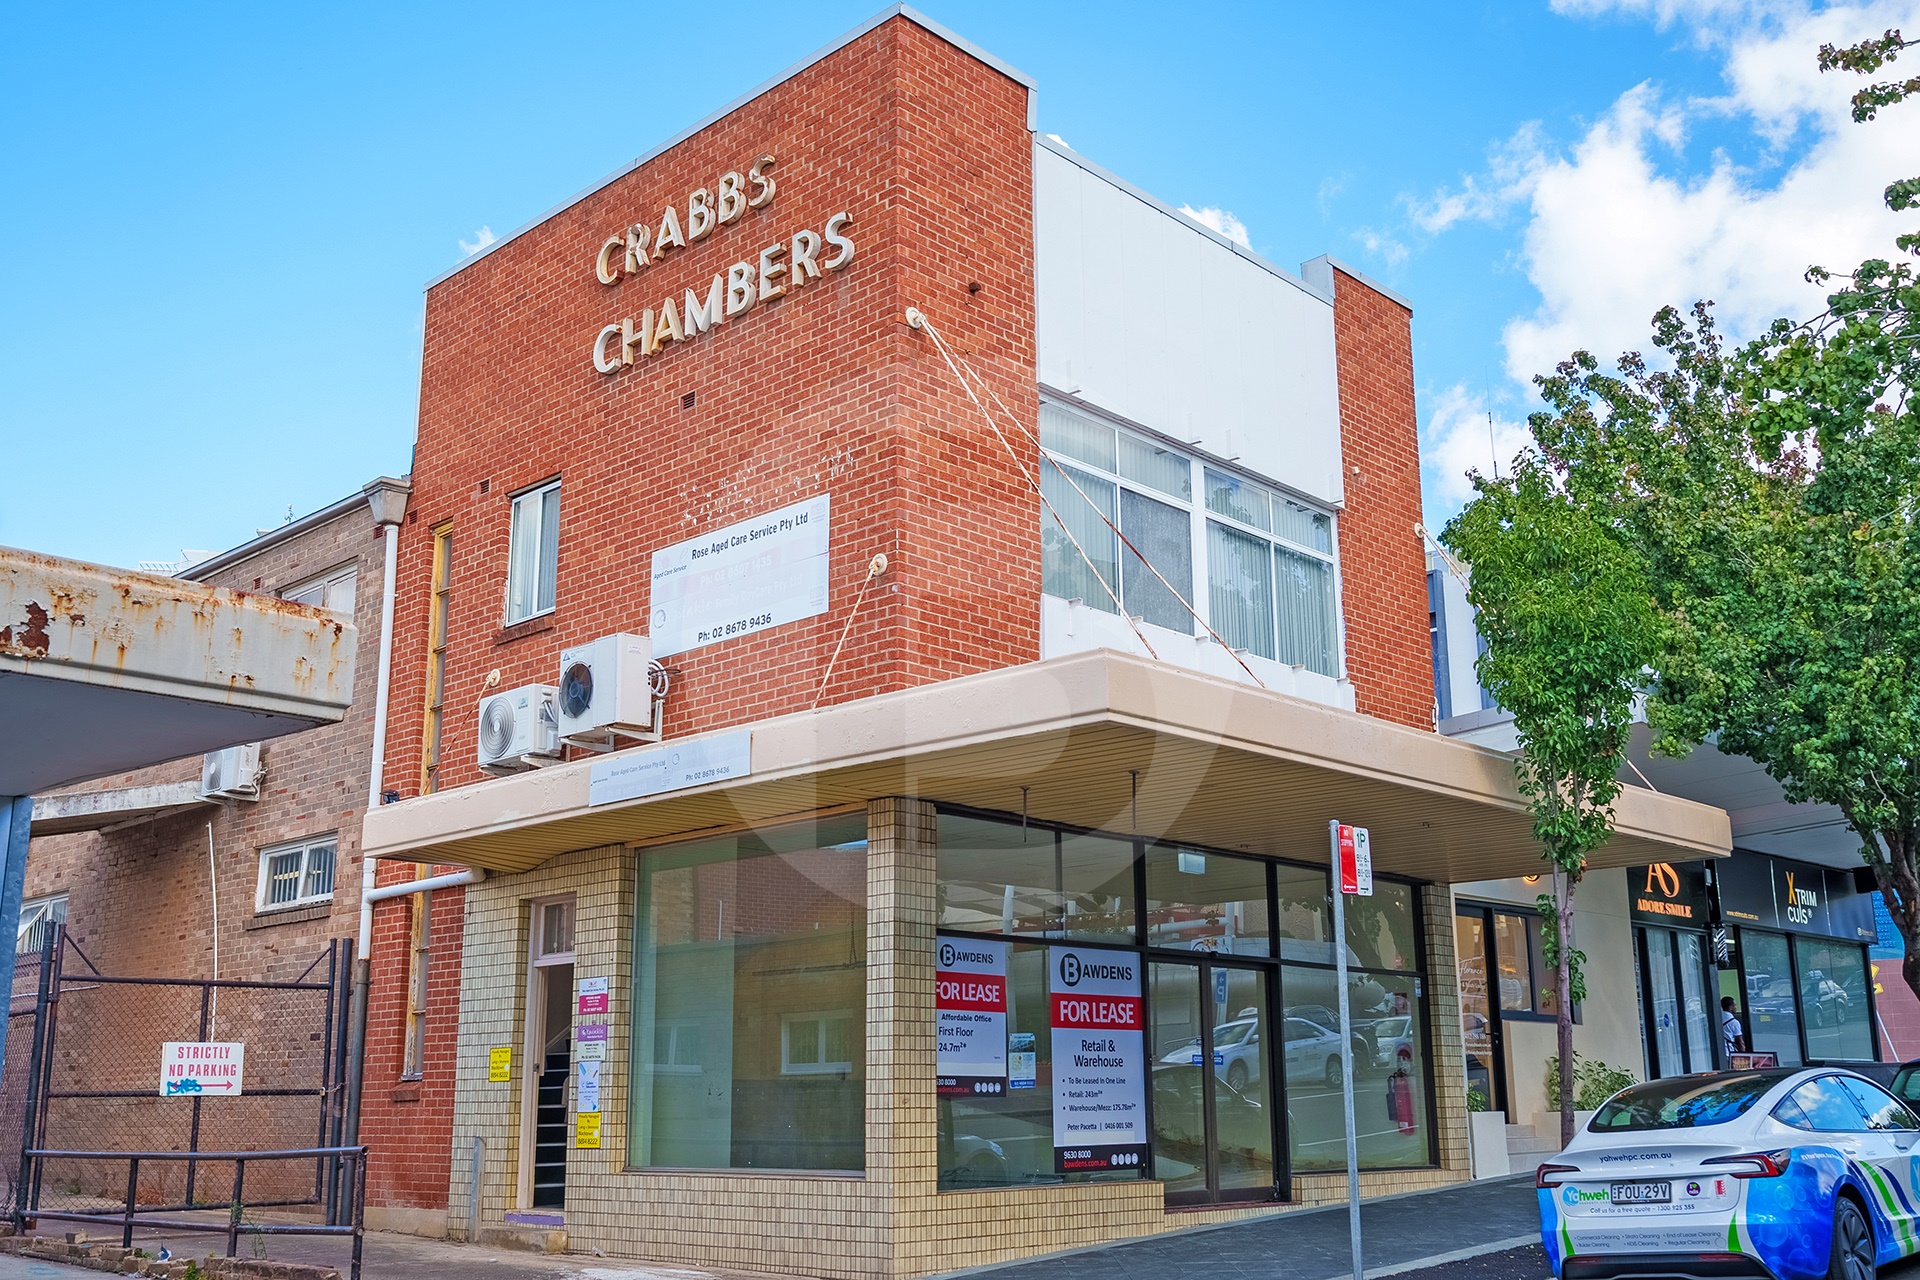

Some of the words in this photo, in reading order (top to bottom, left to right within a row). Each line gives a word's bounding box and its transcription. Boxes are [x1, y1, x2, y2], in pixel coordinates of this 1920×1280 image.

[596, 153, 777, 286] CRABBS
[593, 211, 855, 375] CHAMBERS
[691, 547, 709, 560] Rose
[711, 538, 729, 555] Aged
[730, 533, 748, 547] Care
[749, 523, 778, 541] Service
[779, 520, 793, 532] Pty
[795, 512, 809, 526] Ltd
[697, 632, 710, 643] Ph:
[712, 626, 723, 639] 02
[725, 620, 748, 635] 8678
[749, 612, 773, 629] 9436
[694, 772, 702, 780] 02
[702, 768, 716, 778] 8678
[716, 766, 730, 775] 9436
[1356, 832, 1366, 848] 1P
[1637, 898, 1666, 915] ADORE
[1665, 902, 1693, 918] SMILE
[940, 944, 994, 967] BAWDENS
[1060, 953, 1132, 987] BAWDENS
[962, 984, 1000, 1003] LEASE
[942, 1013, 973, 1022] Affordable
[974, 1014, 992, 1023] Office
[1060, 1000, 1090, 1023] FOR
[1092, 1002, 1134, 1024] LEASE
[938, 1027, 954, 1037] First
[956, 1027, 974, 1037] Floor
[178, 1046, 231, 1059] STRICTLY
[1082, 1039, 1106, 1052] Retail
[1108, 1040, 1116, 1052] &
[1074, 1054, 1124, 1068] Warehouse
[168, 1064, 184, 1076] NO
[188, 1064, 237, 1076] PARKING
[944, 1078, 957, 1086] 8000
[1068, 1103, 1112, 1112] Warehouse/Mezz:
[1104, 1122, 1116, 1130] 0416
[1124, 1121, 1134, 1129] 509
[1064, 1151, 1078, 1160] 9630
[1078, 1150, 1092, 1159] 8000
[1598, 1152, 1672, 1163] yahwehpc.com.au
[1064, 1160, 1107, 1168] bawdens.com.au
[1566, 1188, 1610, 1202] Yahweh
